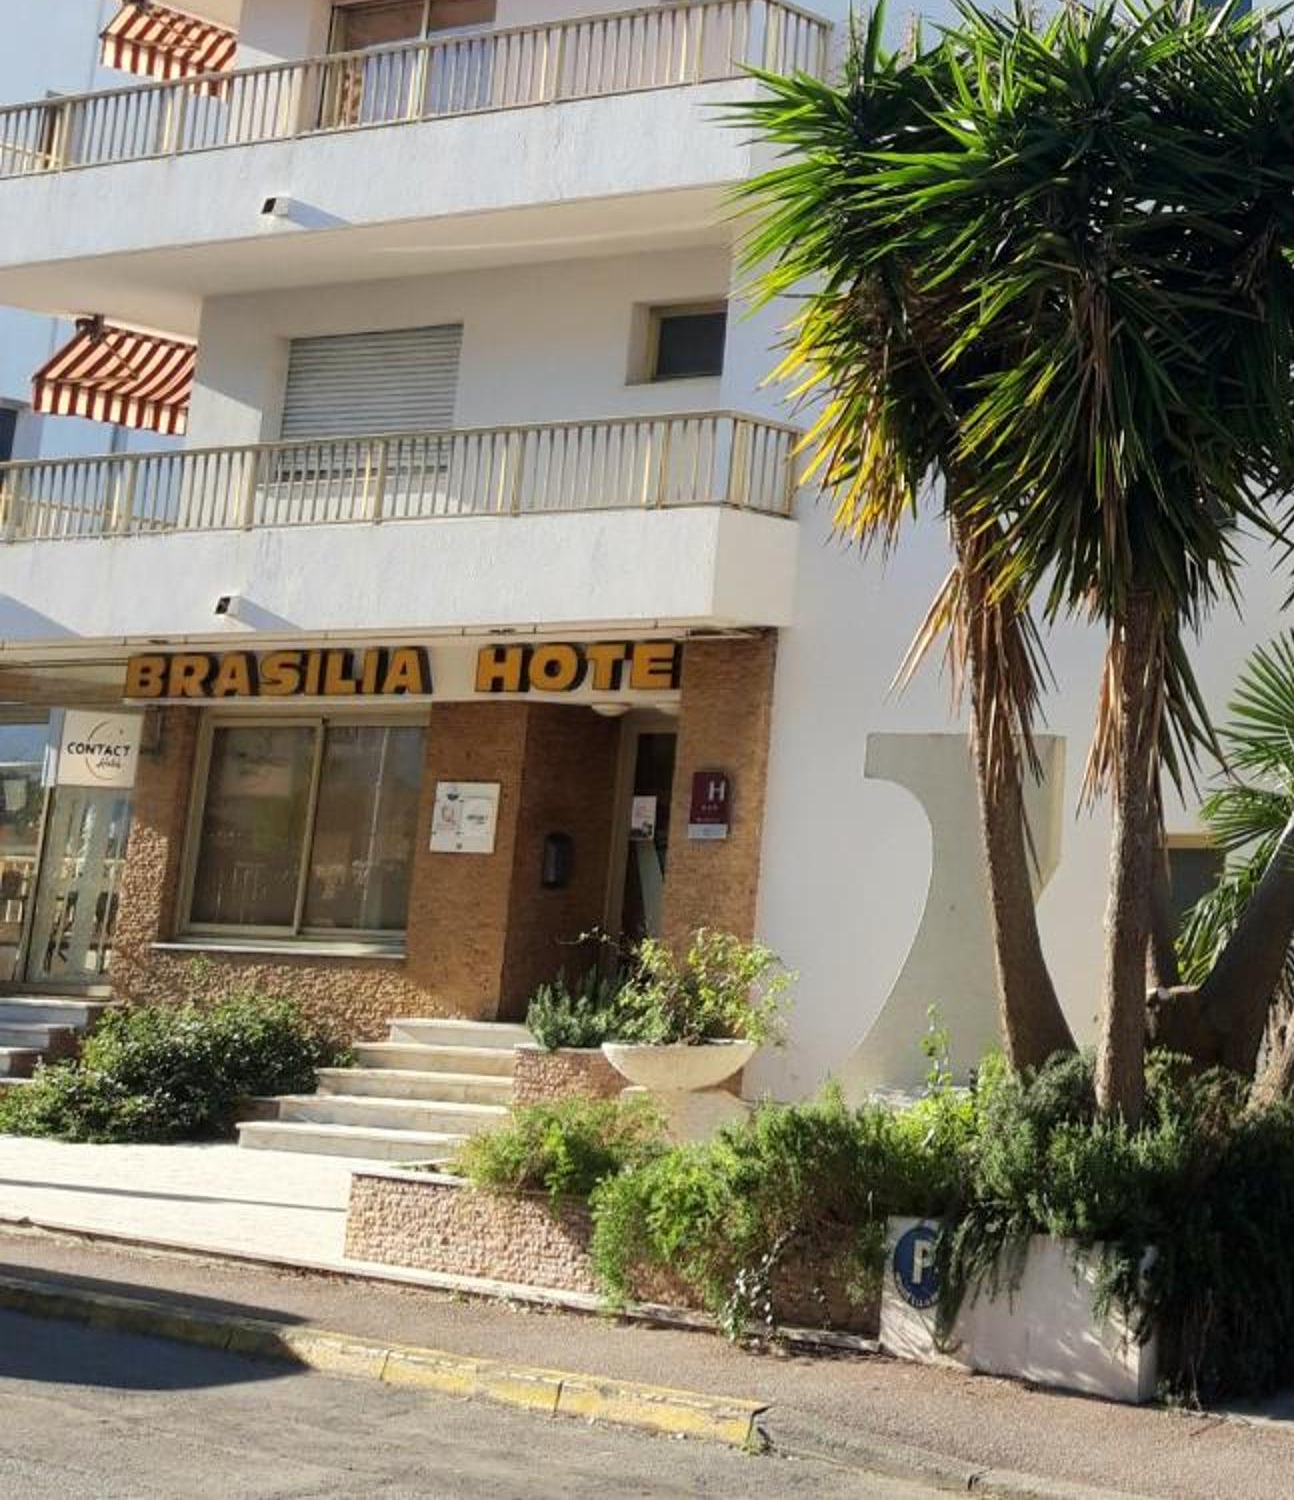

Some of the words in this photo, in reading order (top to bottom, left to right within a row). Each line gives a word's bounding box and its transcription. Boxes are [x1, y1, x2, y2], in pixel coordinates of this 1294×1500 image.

[125, 646, 432, 697] BRASILIA
[475, 640, 684, 692] HOTE
[67, 742, 130, 756] CONTACT
[708, 781, 725, 801] H
[912, 1239, 937, 1285] P
